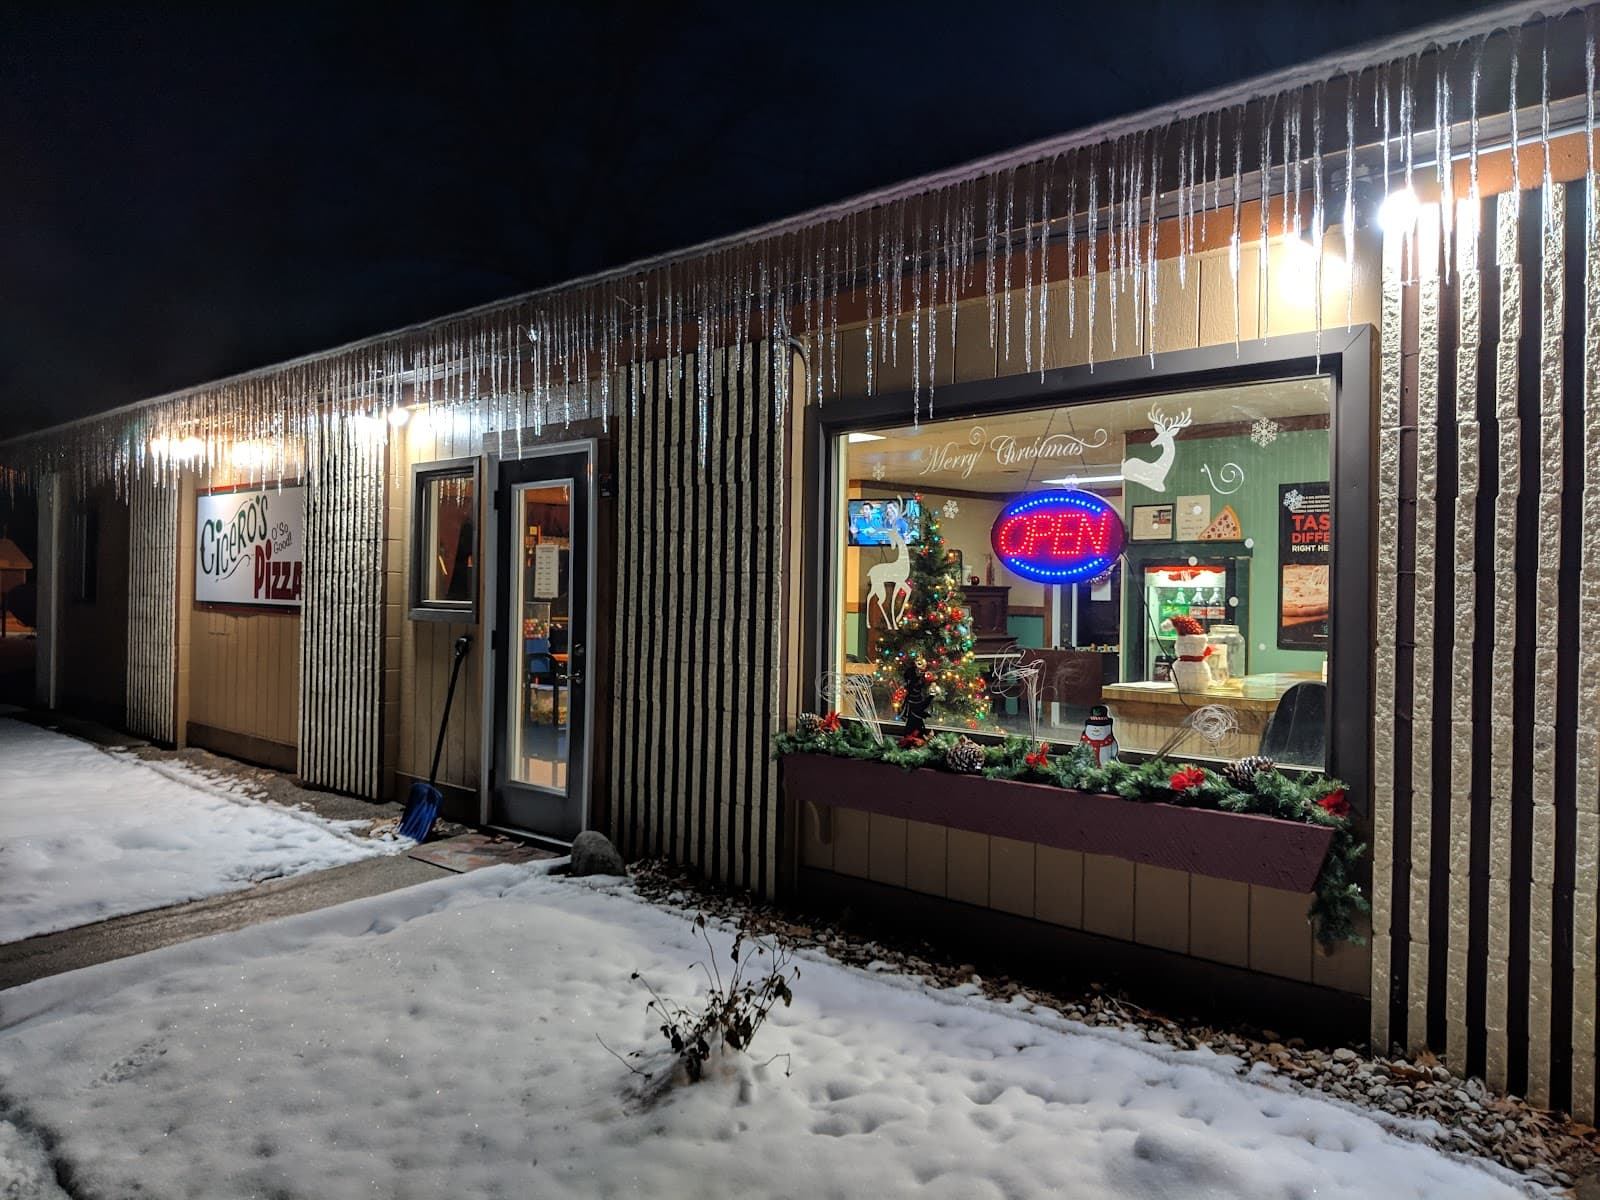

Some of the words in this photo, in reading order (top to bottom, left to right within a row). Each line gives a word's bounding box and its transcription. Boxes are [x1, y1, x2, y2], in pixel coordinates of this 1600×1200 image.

[919, 426, 987, 479] Merry
[990, 428, 1108, 465] Christmas
[1000, 511, 1108, 556] OPEN
[1291, 545, 1316, 553] RIGHT
